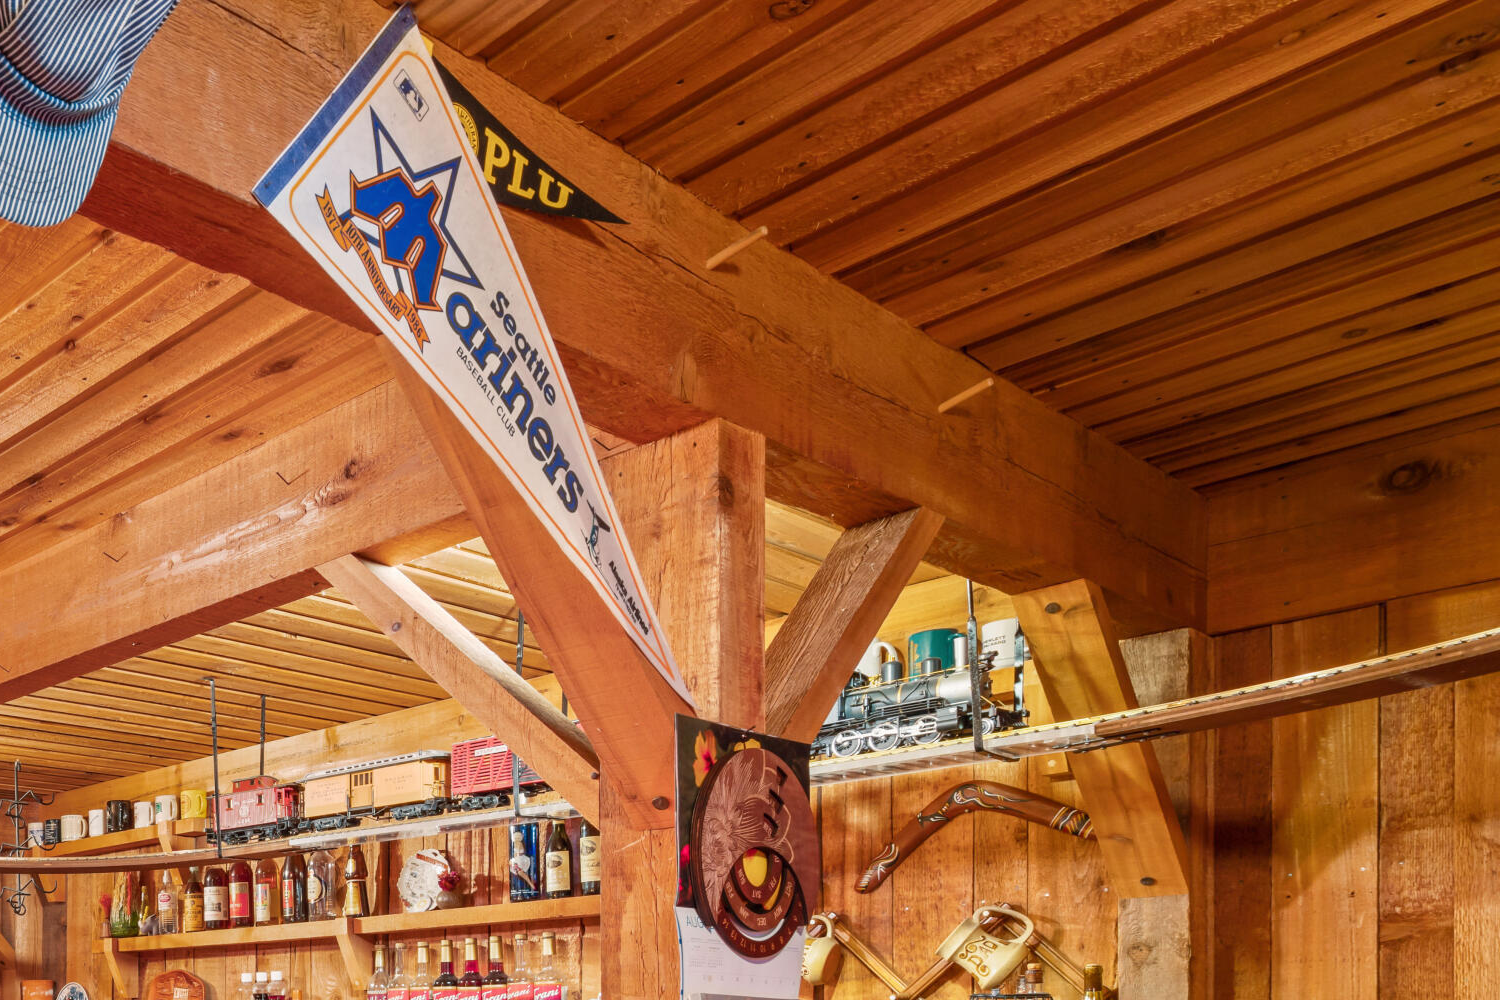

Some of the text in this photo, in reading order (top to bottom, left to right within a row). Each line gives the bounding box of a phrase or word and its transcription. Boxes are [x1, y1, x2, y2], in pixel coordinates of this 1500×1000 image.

[484, 127, 574, 209] PLU
[323, 201, 340, 232] 1977
[344, 222, 403, 317] 10TH ANNIVERSARY
[406, 308, 424, 338] 1986
[490, 290, 556, 406] Seattle
[456, 346, 516, 437] BASEBALL CLUB
